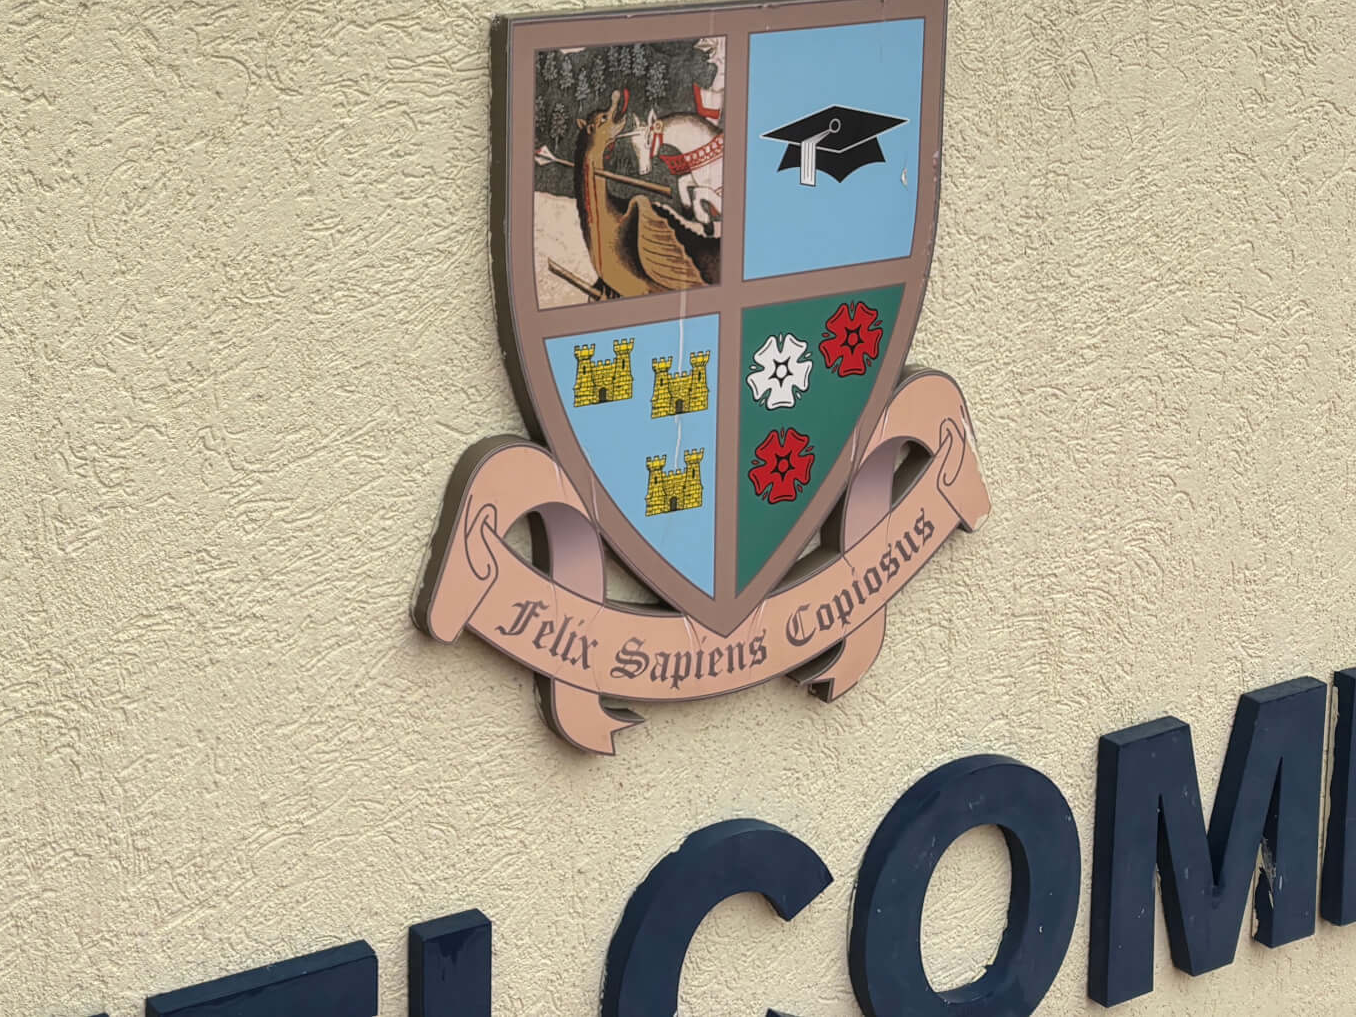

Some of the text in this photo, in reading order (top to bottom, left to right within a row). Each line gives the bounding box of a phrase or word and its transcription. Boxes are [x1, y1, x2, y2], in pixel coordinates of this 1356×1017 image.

[495, 506, 937, 691] Felix Sapiens Copiosus
